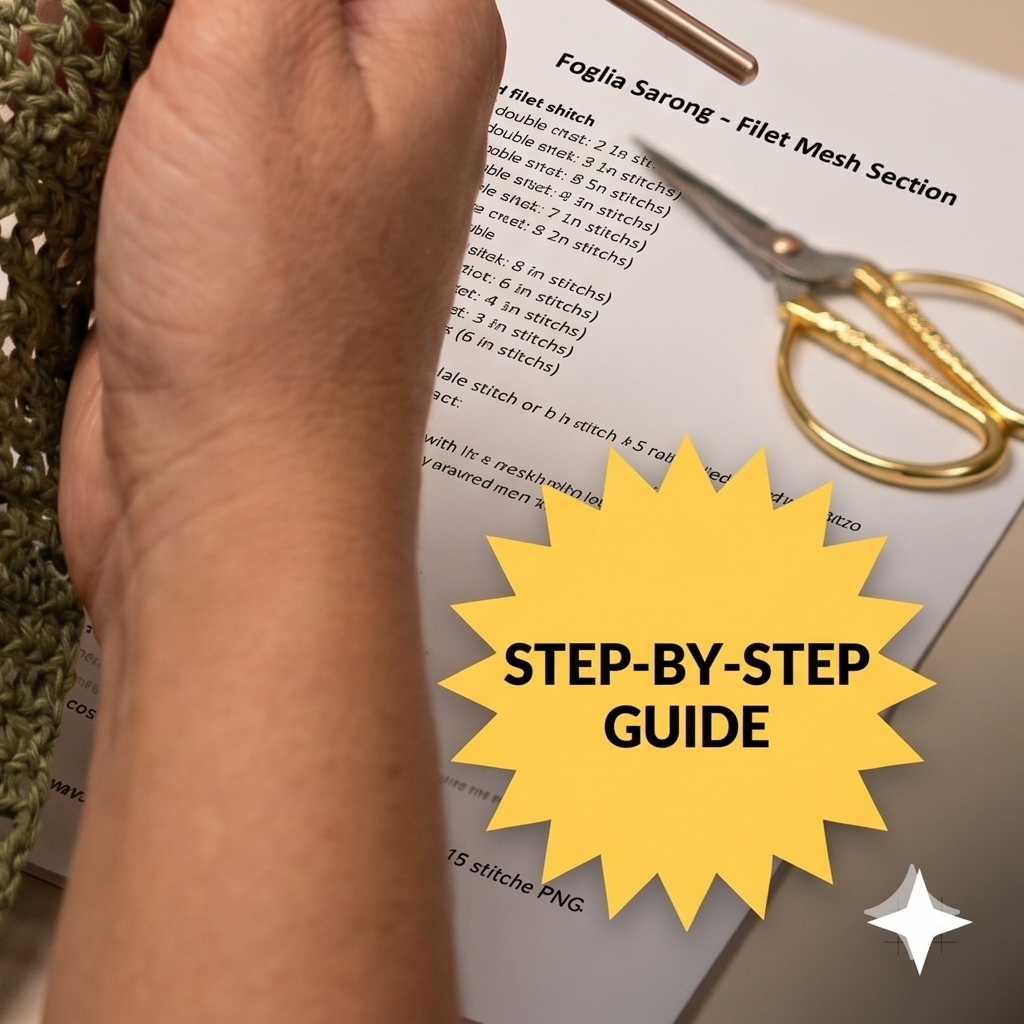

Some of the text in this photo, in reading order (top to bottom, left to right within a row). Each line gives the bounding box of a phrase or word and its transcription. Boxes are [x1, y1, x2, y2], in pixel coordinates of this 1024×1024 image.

[495, 106, 548, 131] double
[593, 140, 607, 152] 2
[509, 87, 545, 109] filet
[545, 102, 596, 127] shitch
[555, 52, 626, 89] Foglia
[631, 79, 715, 124] Sarong
[736, 116, 791, 149] Filet
[794, 137, 862, 173] Mesh
[865, 163, 958, 206] Section
[487, 124, 535, 147] double
[581, 156, 595, 168] 3
[620, 171, 682, 202] stitchs)
[597, 206, 660, 236] stitchs)
[610, 190, 671, 219] stitchs)
[547, 207, 560, 219] 7
[585, 223, 647, 254] stitchs)
[547, 230, 569, 246] 2n
[572, 241, 633, 270] stitchs)
[499, 278, 511, 289] 6
[535, 293, 599, 323] stitchs)
[511, 261, 525, 272] 8
[549, 276, 612, 306] stitchs)
[472, 313, 486, 324] 3
[511, 328, 574, 359] stitchs)
[484, 296, 498, 307] 4
[524, 311, 587, 341] stitchs)
[455, 328, 475, 343] (6
[477, 337, 494, 351] in
[497, 346, 560, 377] stitchs)
[471, 380, 518, 405] stitch
[521, 400, 543, 413] or
[573, 419, 617, 442] stitch
[425, 433, 458, 454] with
[494, 484, 531, 504] men
[447, 849, 469, 867] 15
[469, 862, 534, 894] stitche
